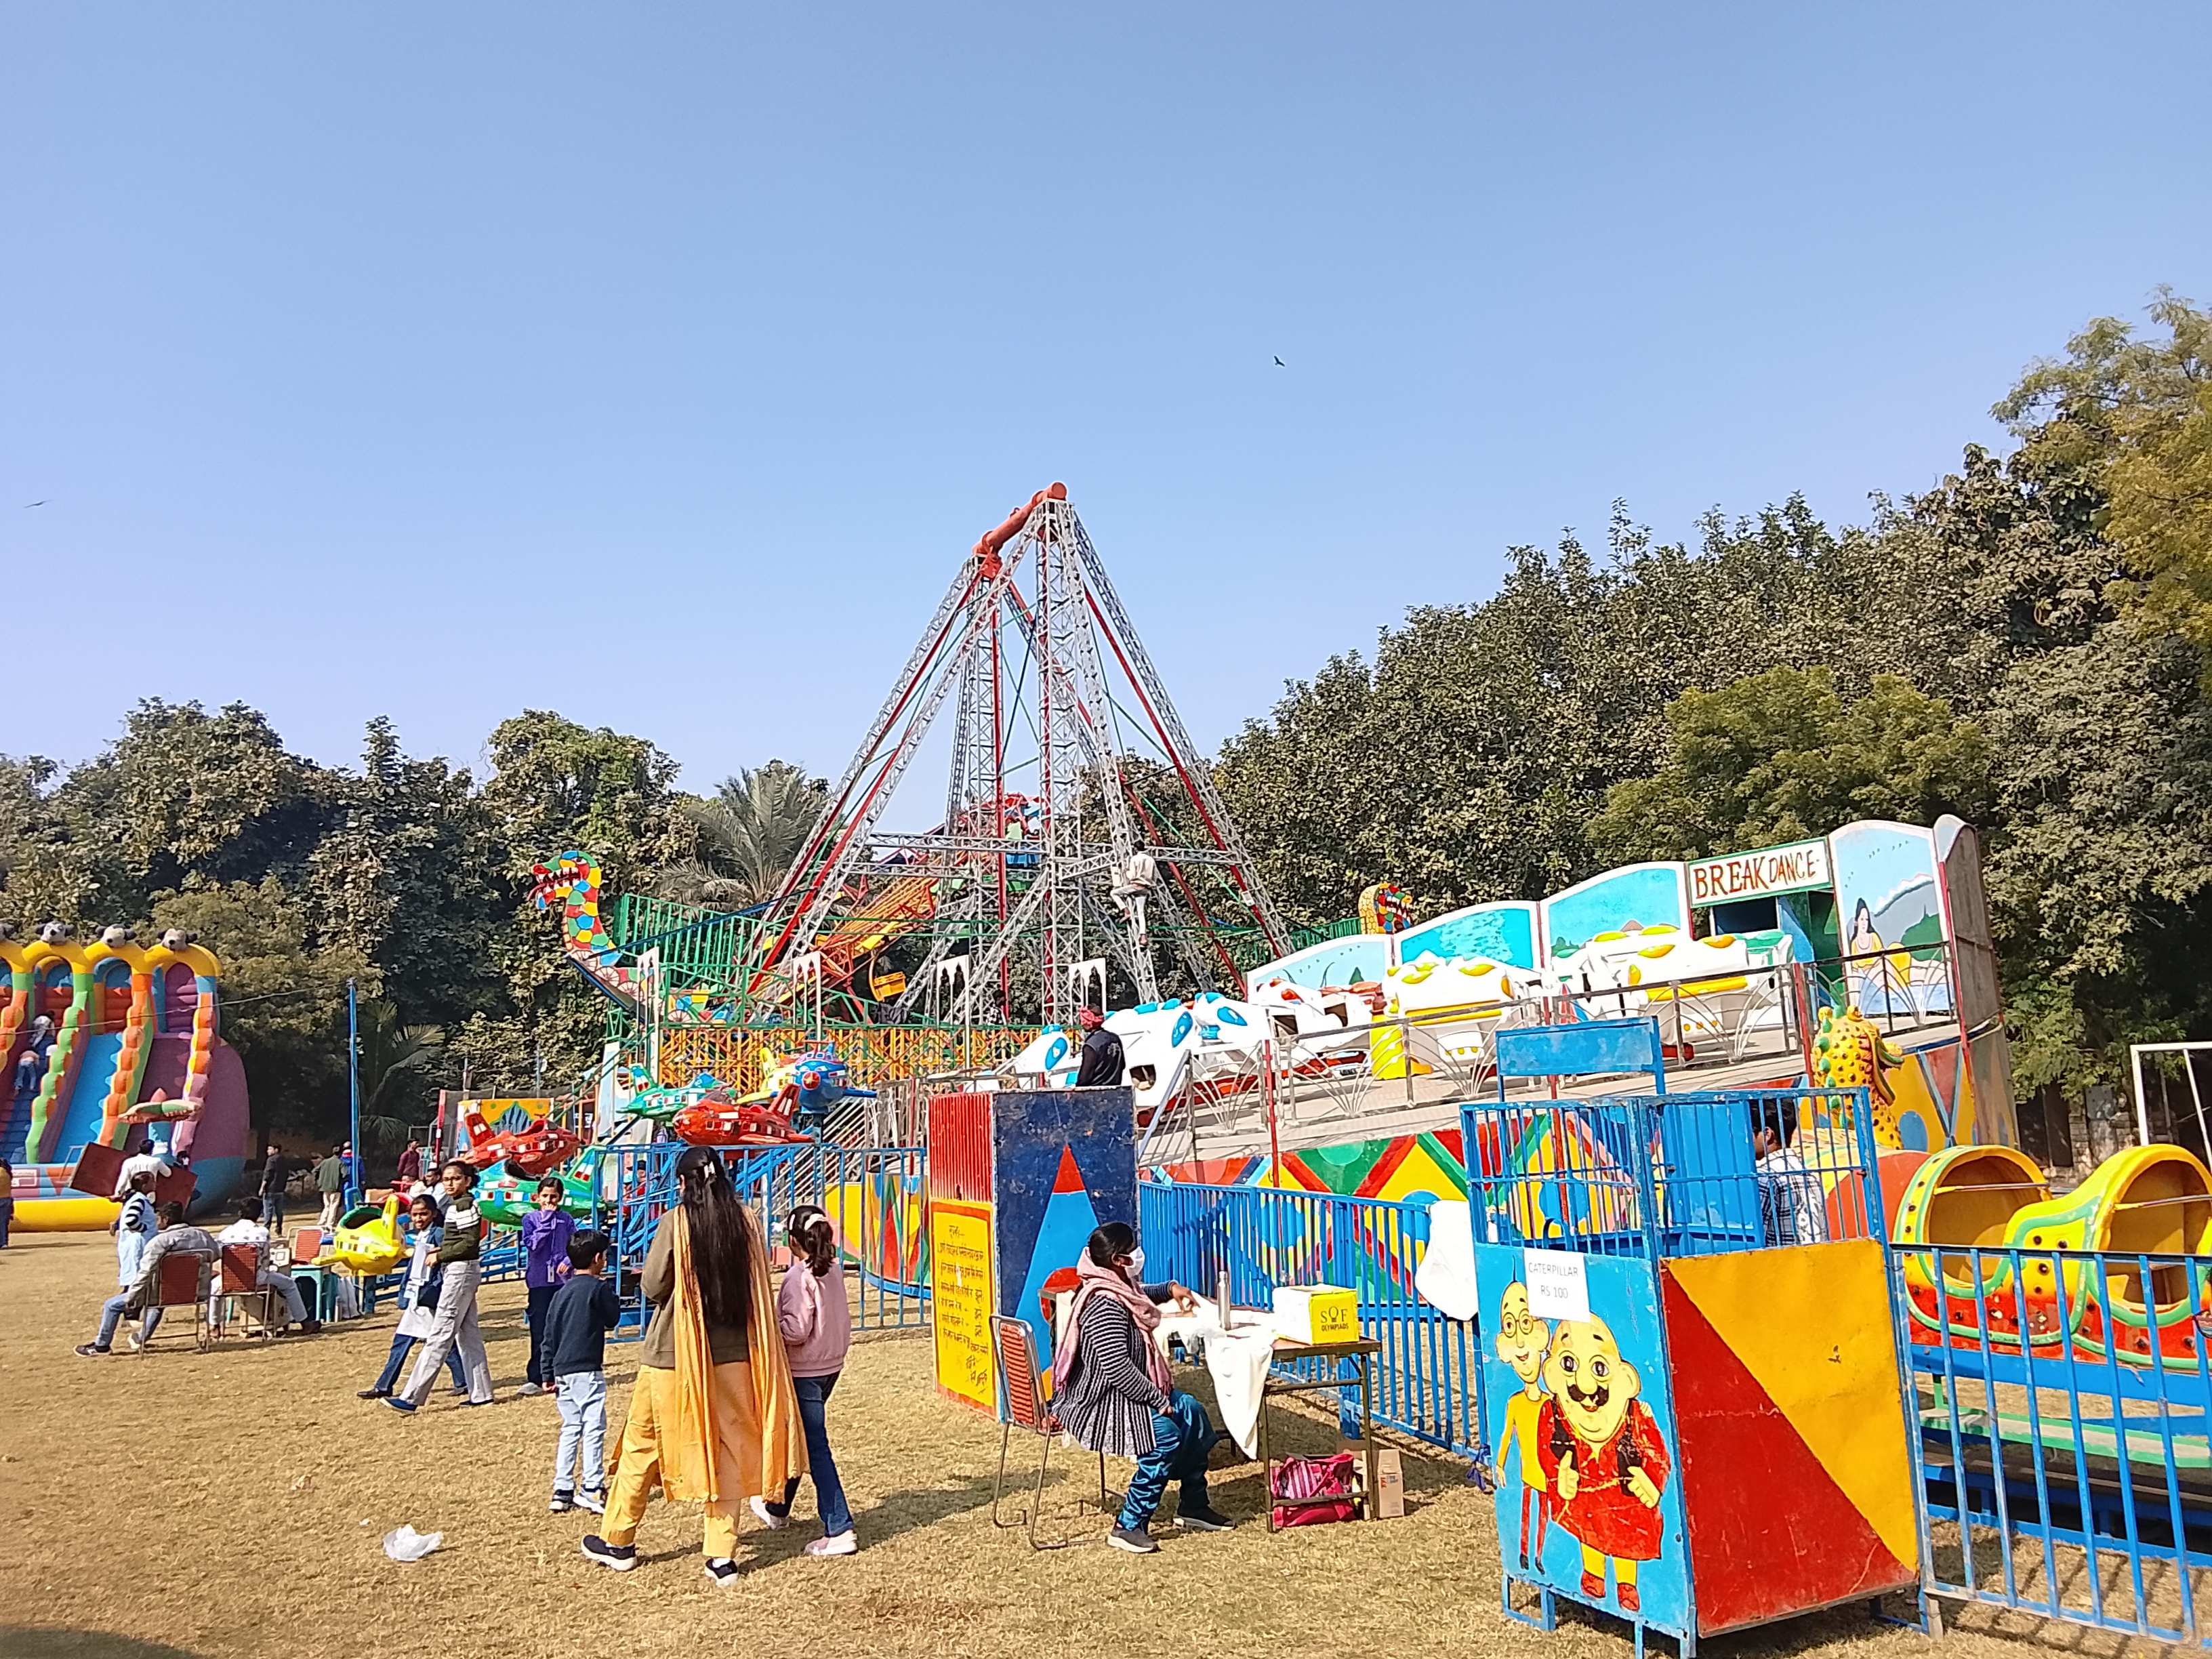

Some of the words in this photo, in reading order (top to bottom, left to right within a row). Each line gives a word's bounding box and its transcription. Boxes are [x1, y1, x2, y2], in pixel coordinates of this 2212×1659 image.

[1693, 855, 1769, 899] BREAK
[1528, 1262, 1578, 1277] CATERPILLAR
[1540, 1285, 1551, 1297] RS
[1553, 1286, 1569, 1299] 100
[1320, 1306, 1349, 1324] SOF
[1321, 1322, 1349, 1332] OLYMPIADS
